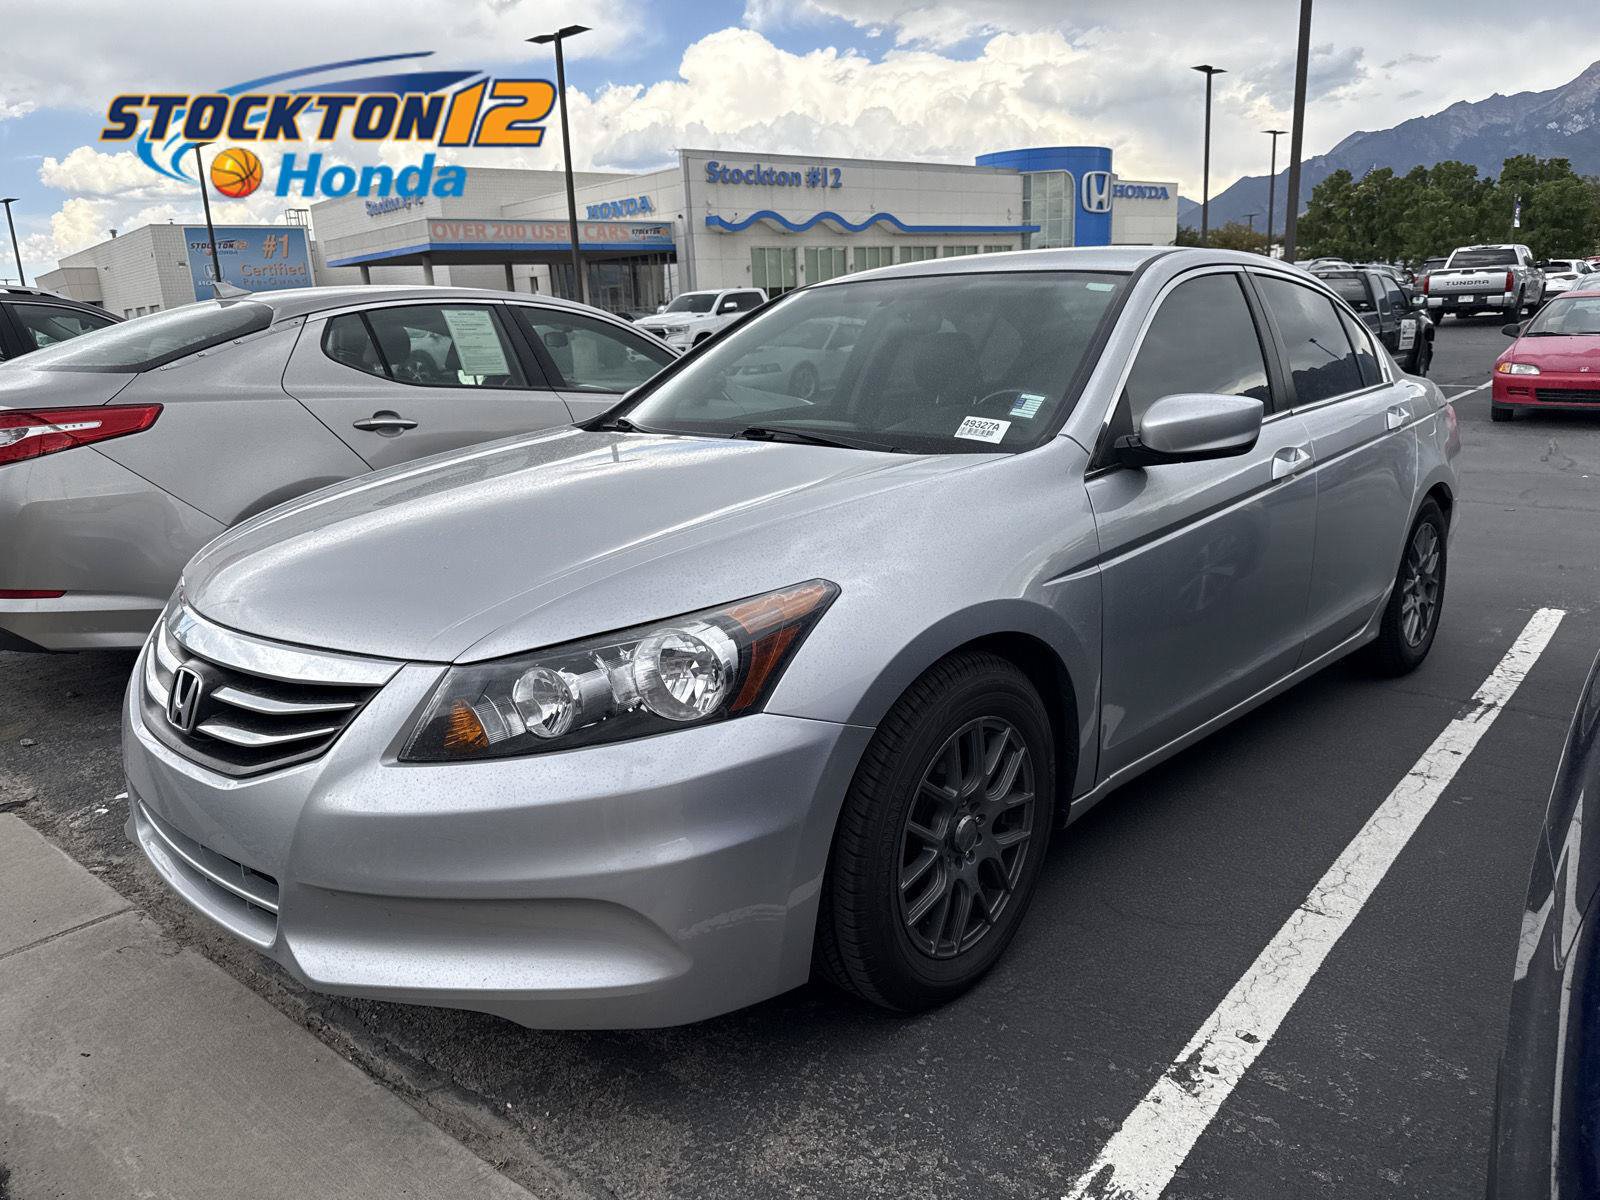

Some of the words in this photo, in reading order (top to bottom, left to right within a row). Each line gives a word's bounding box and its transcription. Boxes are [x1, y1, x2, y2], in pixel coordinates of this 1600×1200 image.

[705, 161, 802, 187] Stockton
[806, 166, 843, 189] #12
[1112, 184, 1169, 200] HONDA
[586, 195, 656, 220] HONDA
[431, 224, 487, 241] OVER
[492, 224, 527, 241] 200
[583, 224, 630, 241] CARS
[263, 234, 290, 259] #1
[240, 262, 306, 277] Certified
[1444, 279, 1490, 287] TUNDRA
[963, 419, 1000, 432] 49327A
